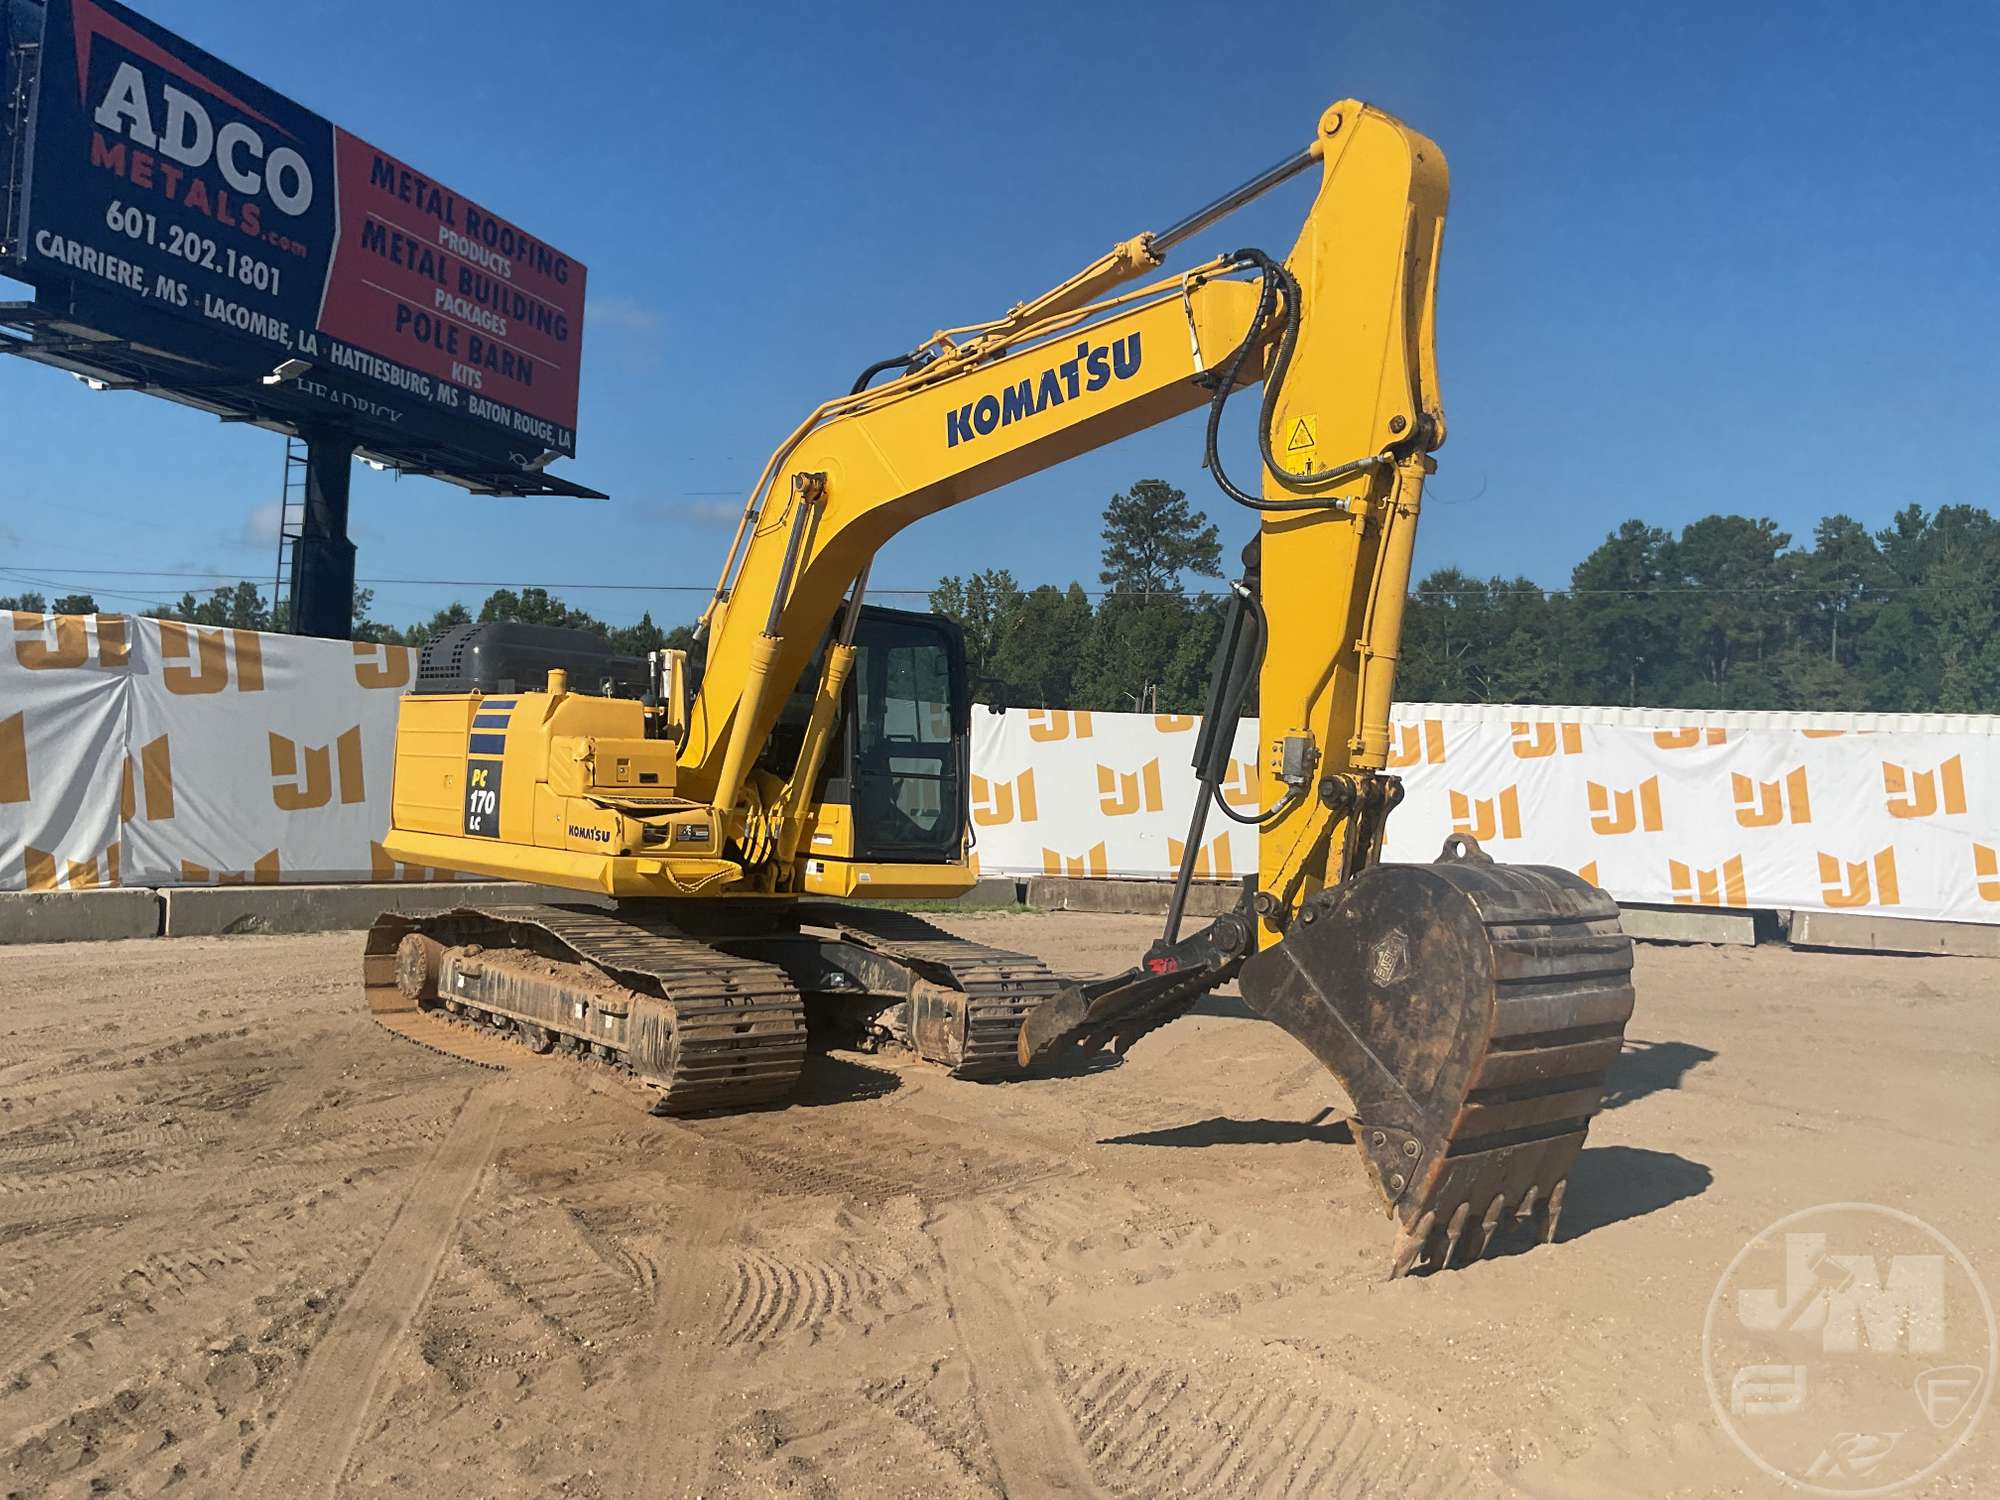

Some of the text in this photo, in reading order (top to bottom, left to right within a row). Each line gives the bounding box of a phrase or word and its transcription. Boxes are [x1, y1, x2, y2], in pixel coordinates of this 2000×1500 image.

[94, 62, 313, 216] ADCO
[106, 200, 280, 295] 601.202.1801
[370, 155, 568, 285] METAL ROOFING
[438, 225, 512, 279] PRODUCTS
[361, 219, 568, 341] METAL BUILDING
[435, 288, 507, 337] PACKAGES
[35, 230, 572, 449] CARRIERE, MS LACOMBE, LA HATTIESBURG, MS BATON ROUGE, LA
[395, 302, 533, 387] POLE BARN
[452, 360, 482, 390] KITS
[947, 331, 1142, 449] KOMATSU
[470, 789, 496, 815] 170
[471, 768, 488, 788] PC
[469, 816, 481, 831] LC
[568, 824, 611, 843] KOMATSU
